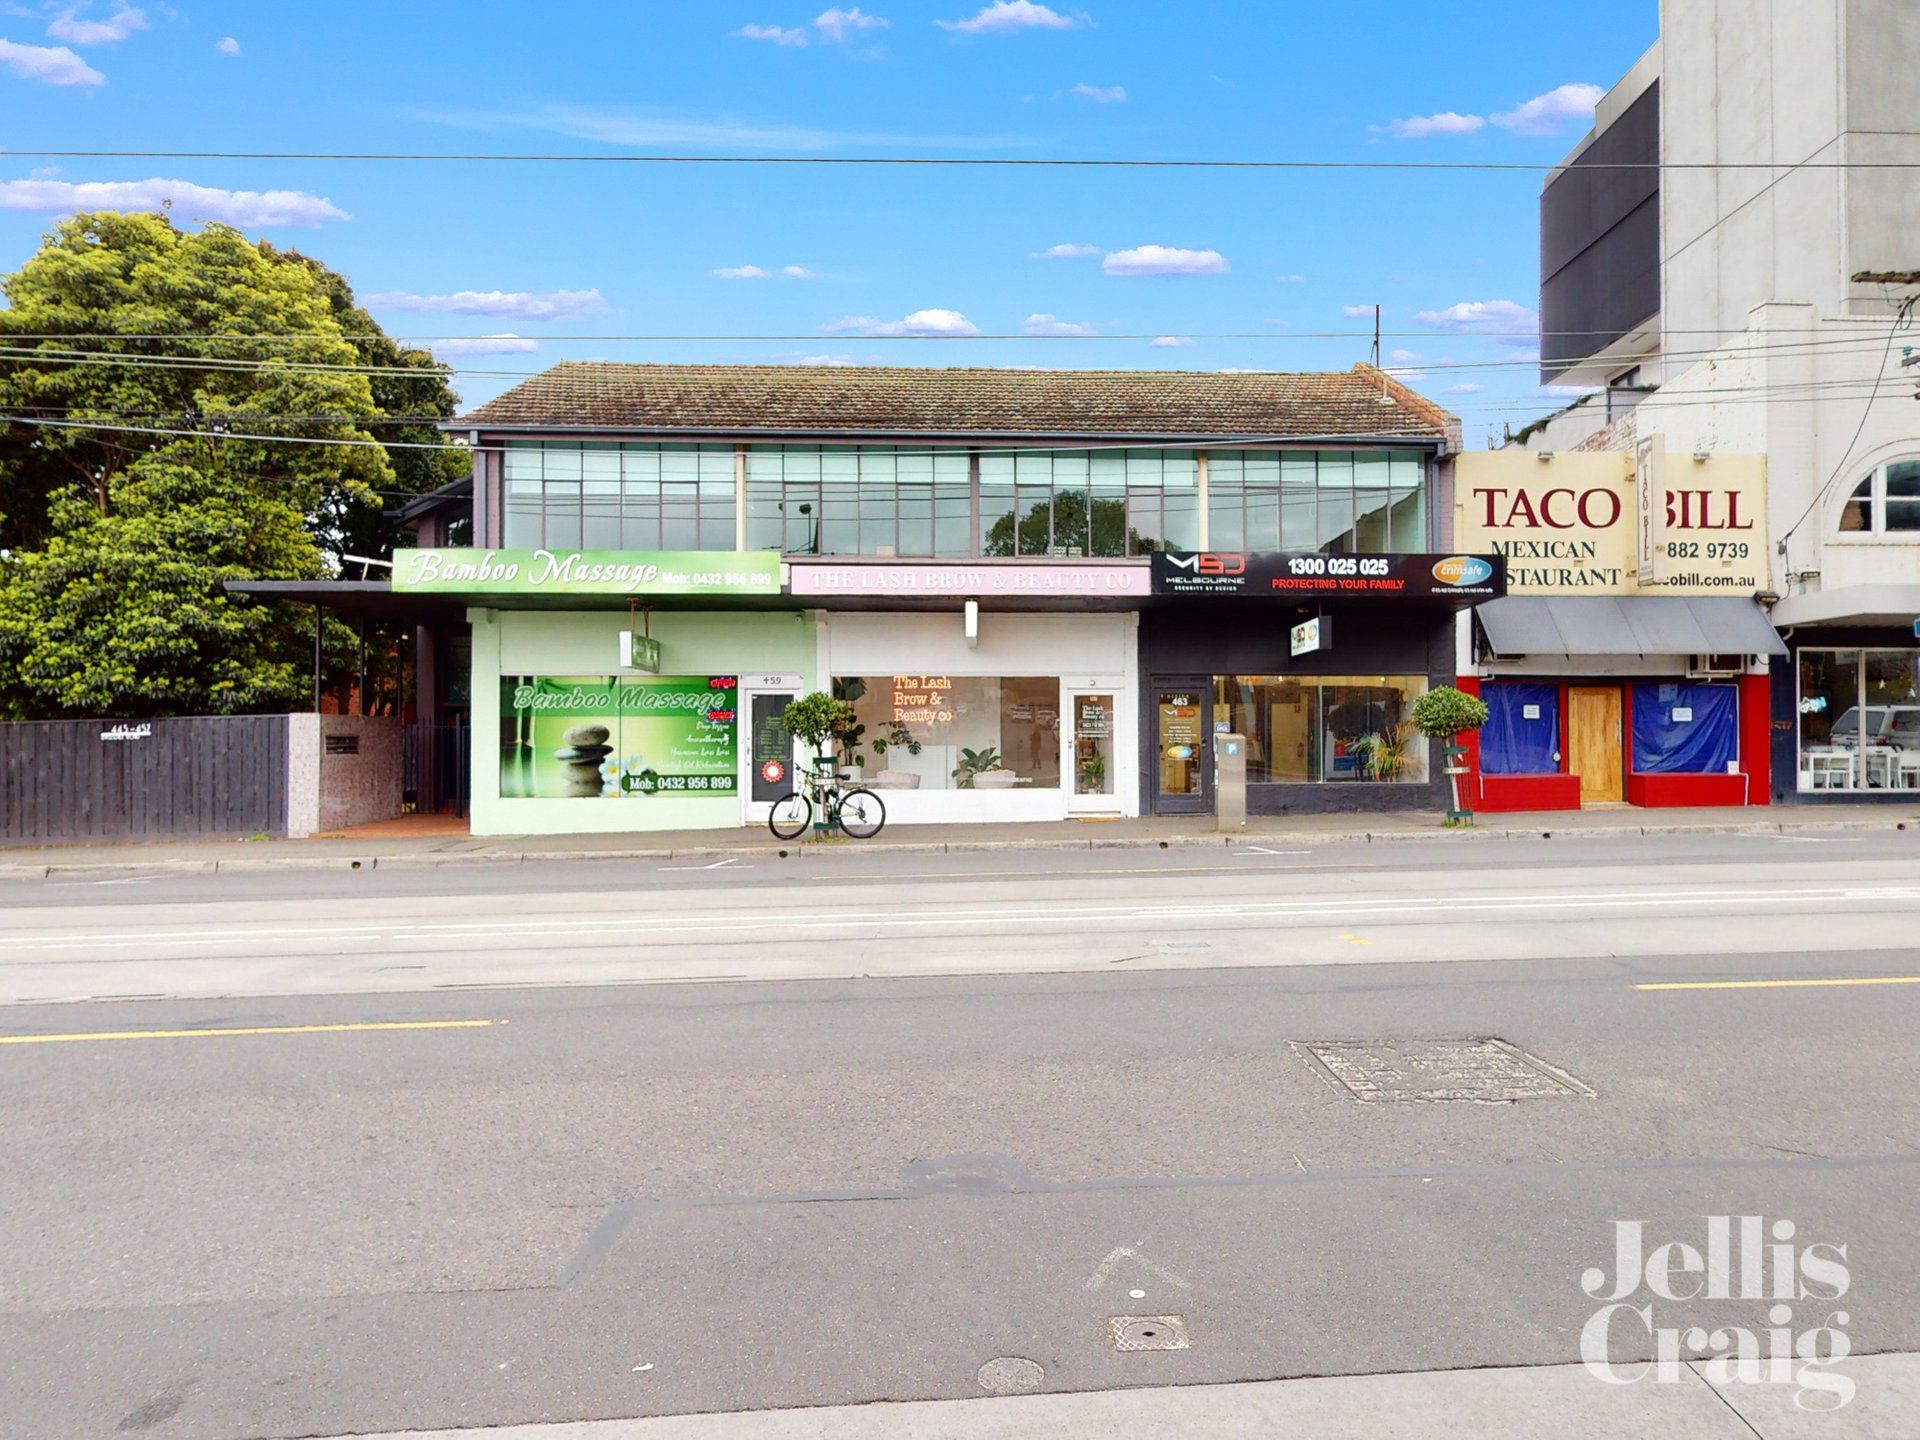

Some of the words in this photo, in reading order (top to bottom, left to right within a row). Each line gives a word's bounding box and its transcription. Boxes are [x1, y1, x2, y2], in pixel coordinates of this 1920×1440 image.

[1473, 487, 1621, 529] TACO
[1490, 540, 1597, 559] MEXICAN
[1666, 541, 1699, 559] 882
[1706, 542, 1749, 559] 9739
[408, 551, 520, 585] Bamboo
[527, 549, 658, 592] Massage
[662, 572, 691, 585] Mob:
[692, 572, 721, 585] 0432
[724, 572, 747, 585] 956
[749, 572, 772, 585] 899
[1288, 558, 1325, 575] 1300
[1327, 558, 1358, 575] 025
[1359, 558, 1389, 576] 025
[1440, 564, 1483, 576] crimsafe
[811, 571, 854, 589] THE
[860, 571, 918, 589] LASH
[924, 571, 985, 589] BROW
[992, 572, 1007, 589] &
[1014, 572, 1099, 589] BEAUTY
[1105, 572, 1132, 589] CO
[1165, 577, 1246, 585] MELBOURNE
[1271, 579, 1337, 590] PROTECTING
[1338, 579, 1368, 590] YOUR
[1369, 579, 1405, 590] FAMILY
[1505, 567, 1622, 587] STAURANT
[1662, 572, 1756, 587] obill.com.au
[893, 675, 919, 690] The
[920, 675, 952, 690] Lash
[513, 686, 610, 708] Bamboo
[617, 686, 727, 716] Massage
[893, 691, 928, 706] Brow
[929, 691, 944, 706] &
[1171, 697, 1189, 706] 463
[893, 708, 938, 727] Beauty
[629, 777, 655, 790] Mob:
[656, 776, 686, 790] 0432
[687, 776, 709, 790] 956
[710, 776, 733, 790] 899
